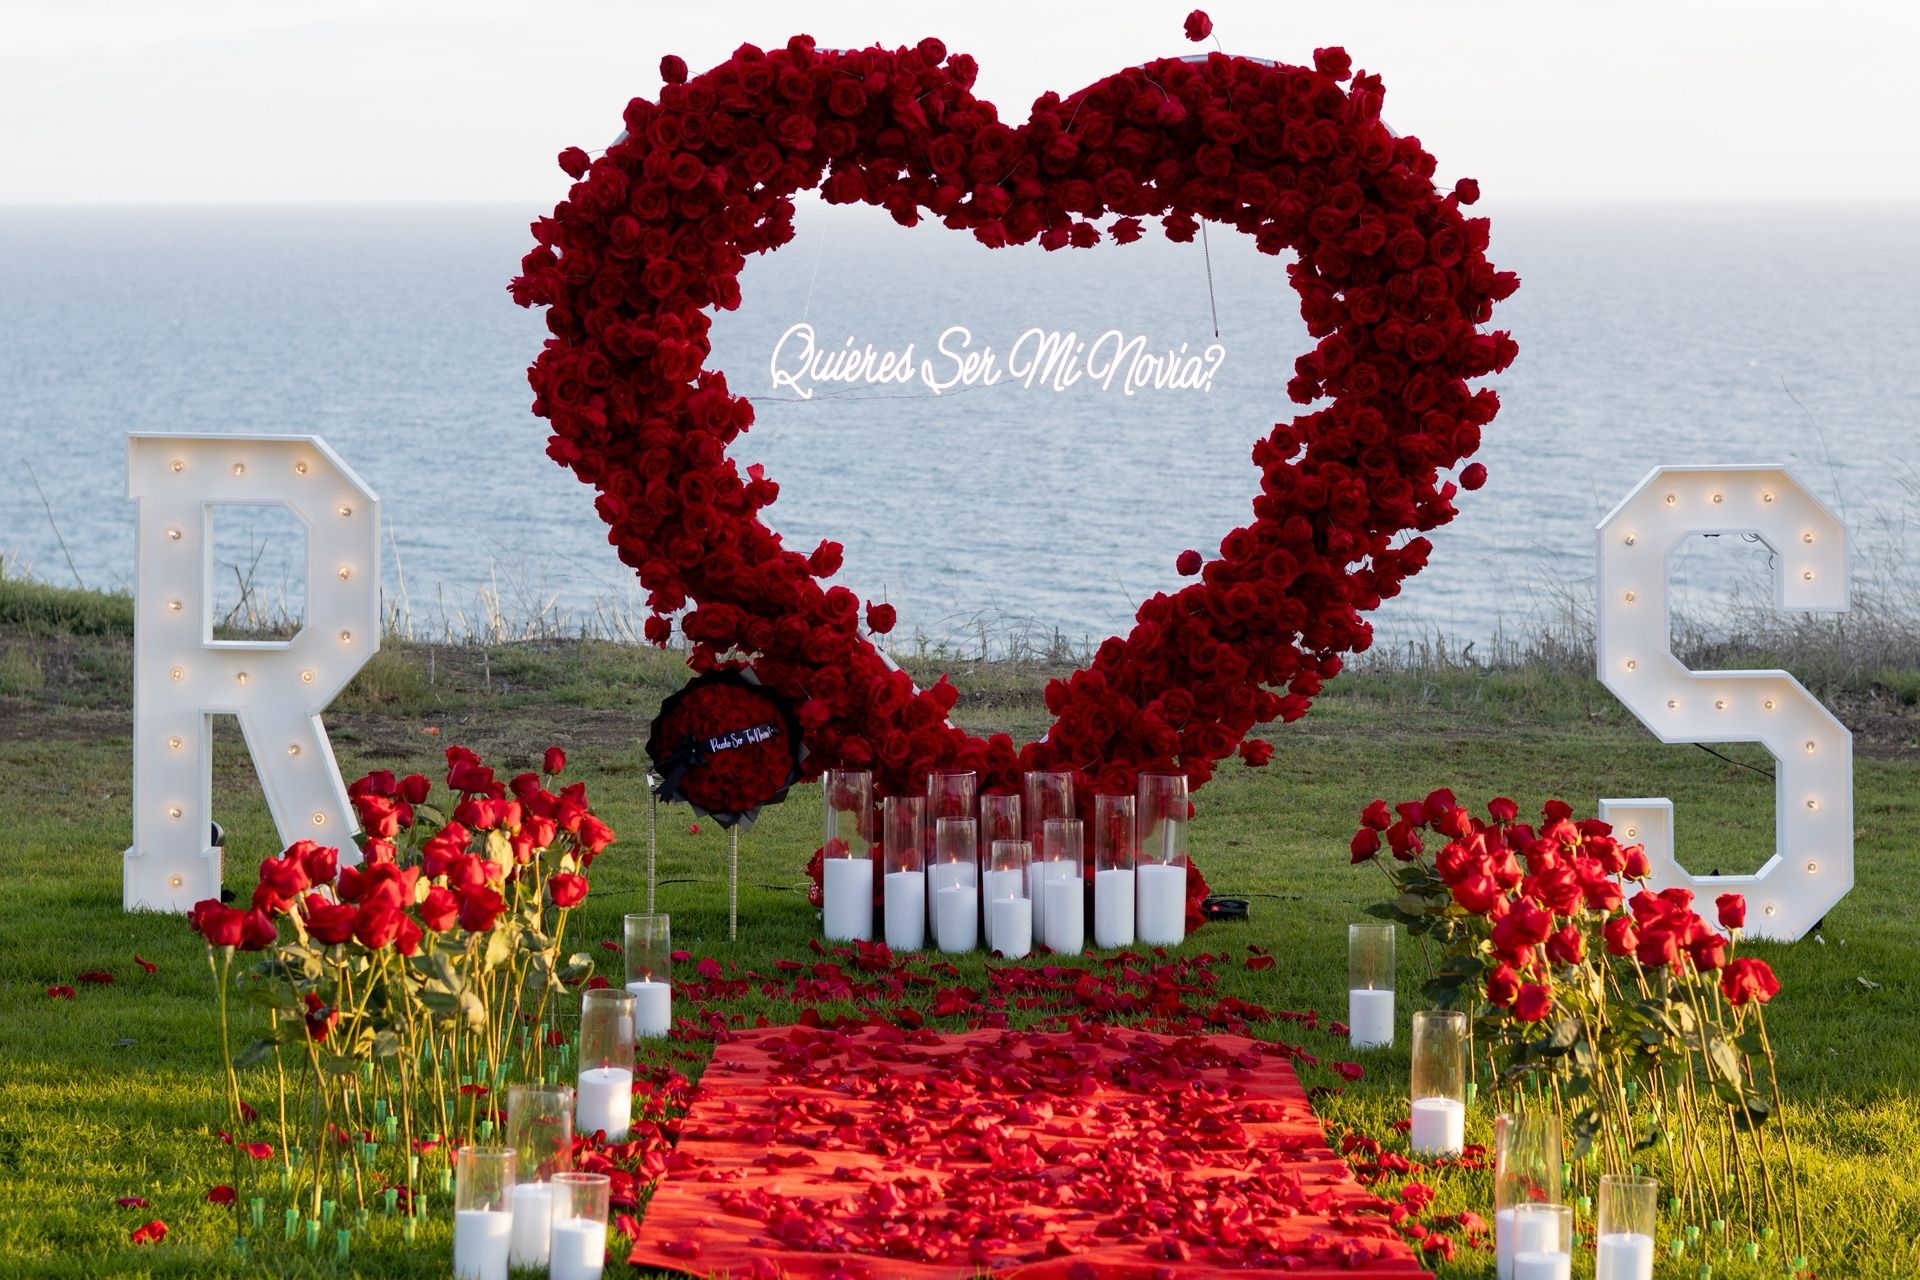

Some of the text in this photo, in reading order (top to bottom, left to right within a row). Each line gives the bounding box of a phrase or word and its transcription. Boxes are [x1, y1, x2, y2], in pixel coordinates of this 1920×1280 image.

[770, 323, 1226, 398] Quieres Ser Mi Novia?
[123, 432, 381, 913] R
[1595, 464, 1854, 943] S
